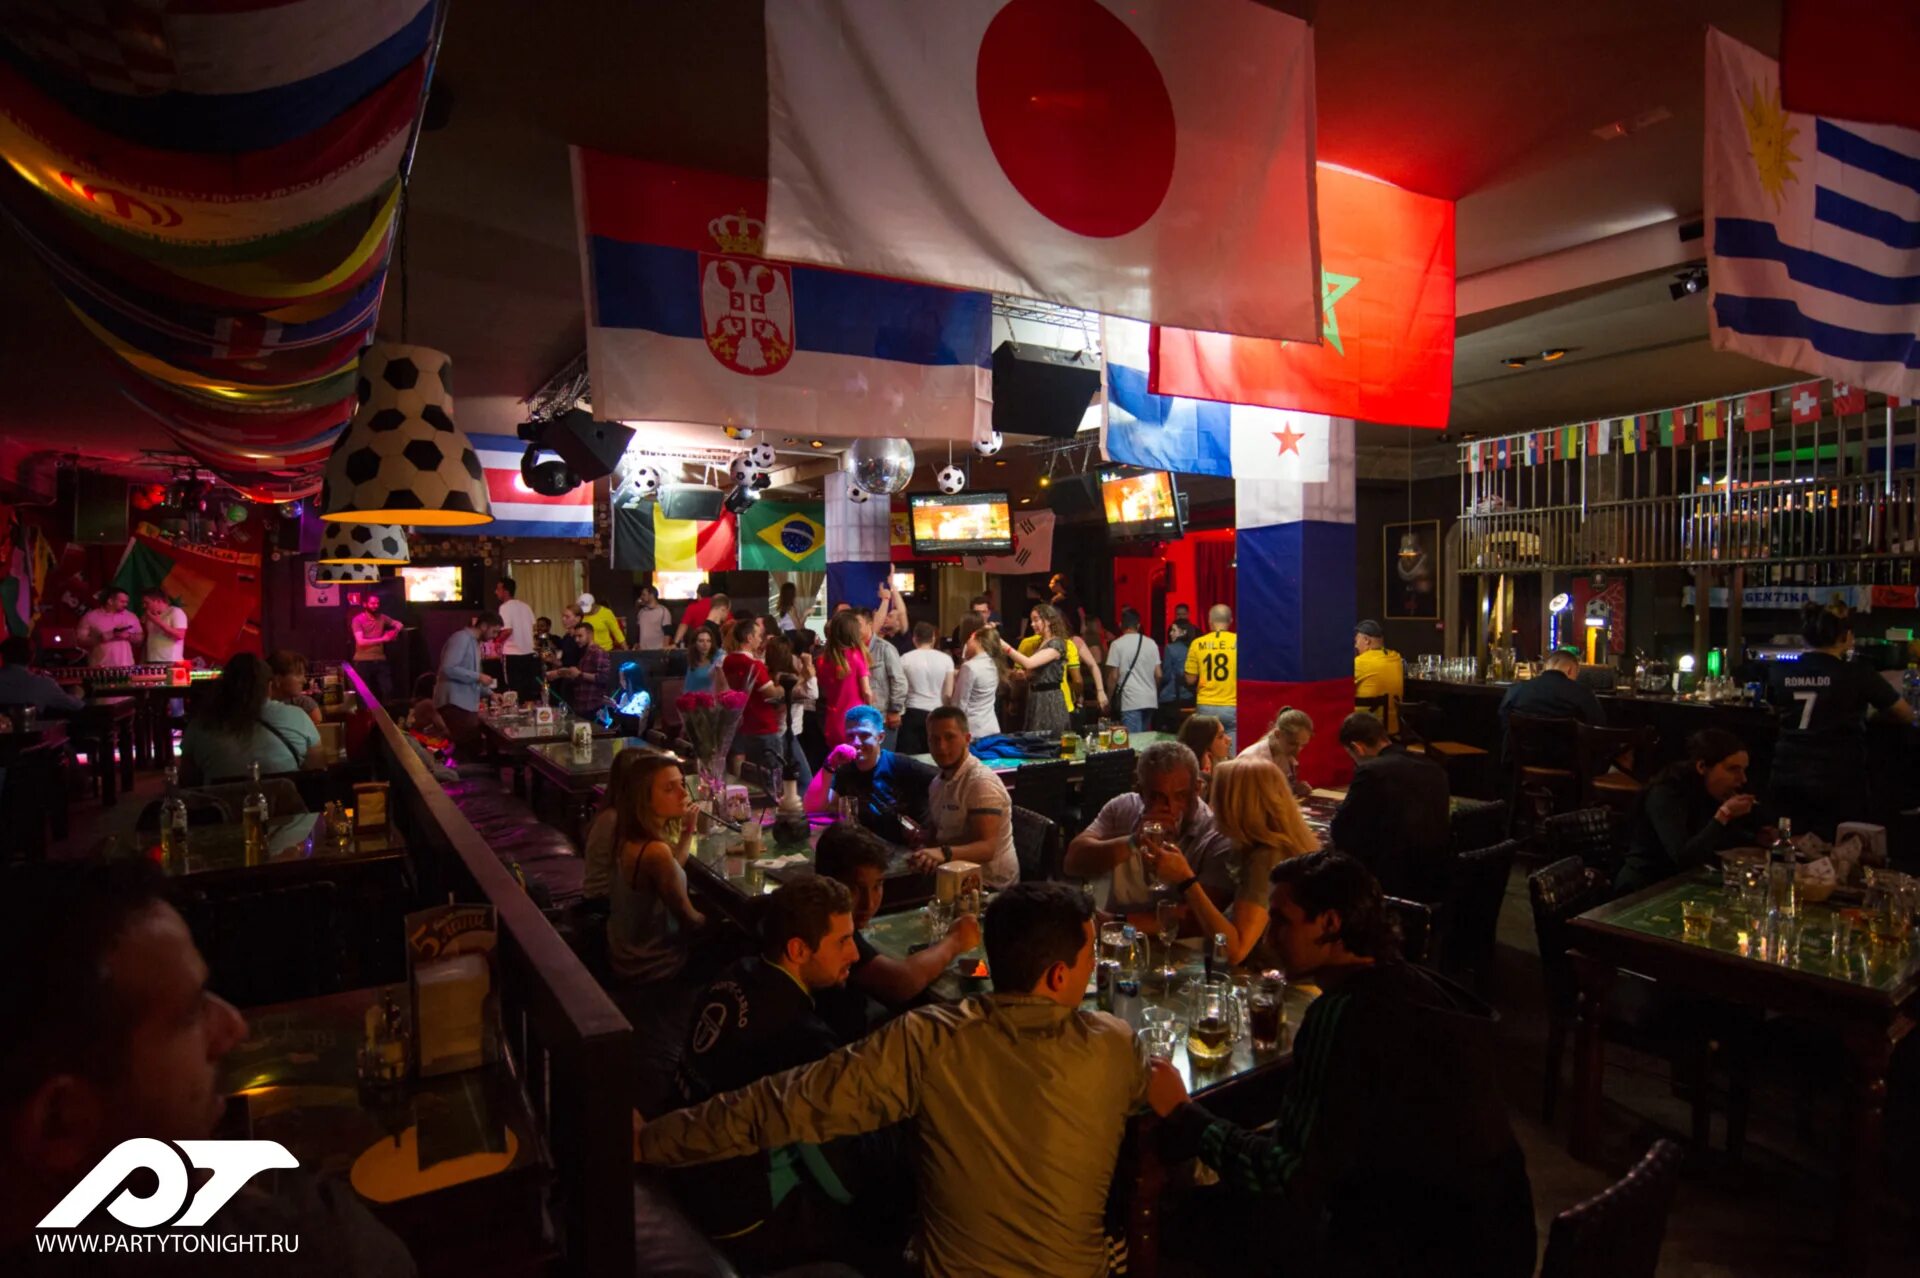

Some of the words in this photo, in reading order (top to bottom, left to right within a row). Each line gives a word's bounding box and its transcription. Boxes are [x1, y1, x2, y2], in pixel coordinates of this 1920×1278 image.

[1744, 591, 1809, 603] GENTINA
[1203, 653, 1229, 681] 18
[1784, 676, 1831, 687] RONALDO
[1793, 690, 1818, 730] 7
